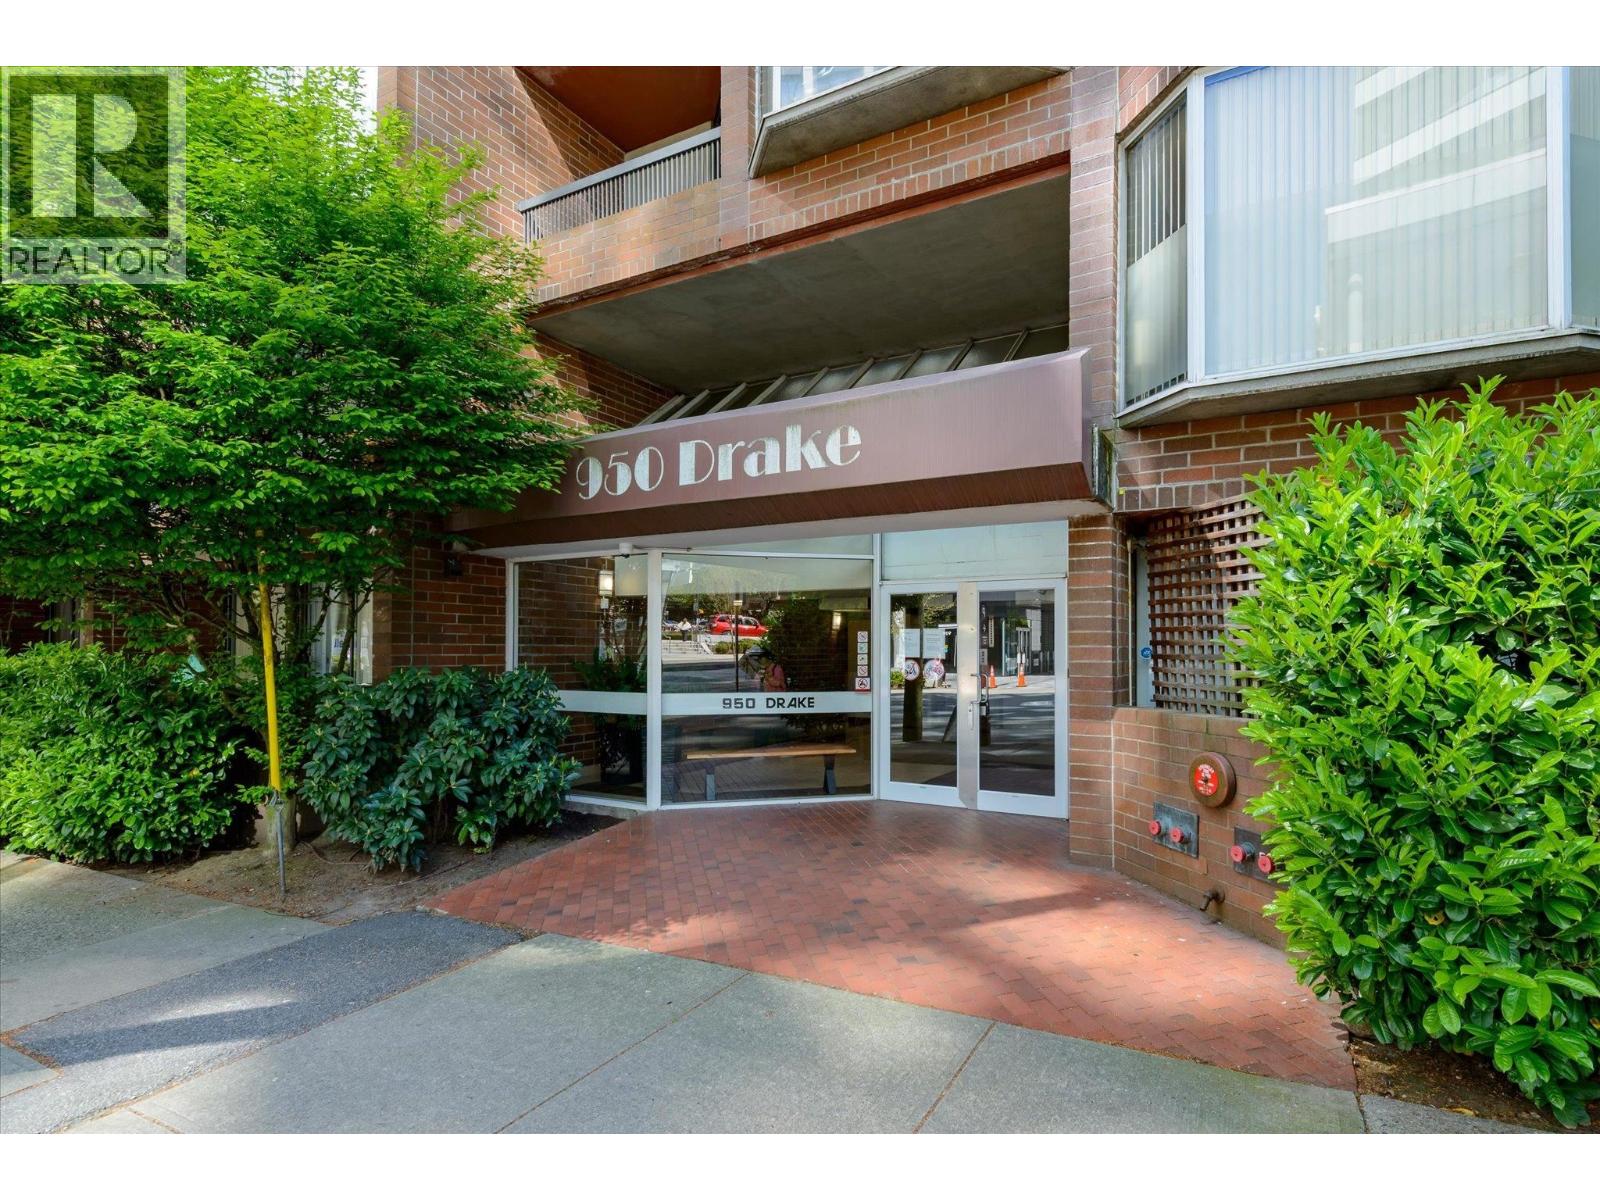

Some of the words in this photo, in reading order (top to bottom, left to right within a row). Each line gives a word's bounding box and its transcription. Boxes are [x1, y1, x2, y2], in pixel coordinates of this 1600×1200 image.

[576, 446, 664, 500] 950
[679, 424, 862, 486] Drake
[722, 697, 756, 709] 950
[765, 696, 815, 709] DRAKE
